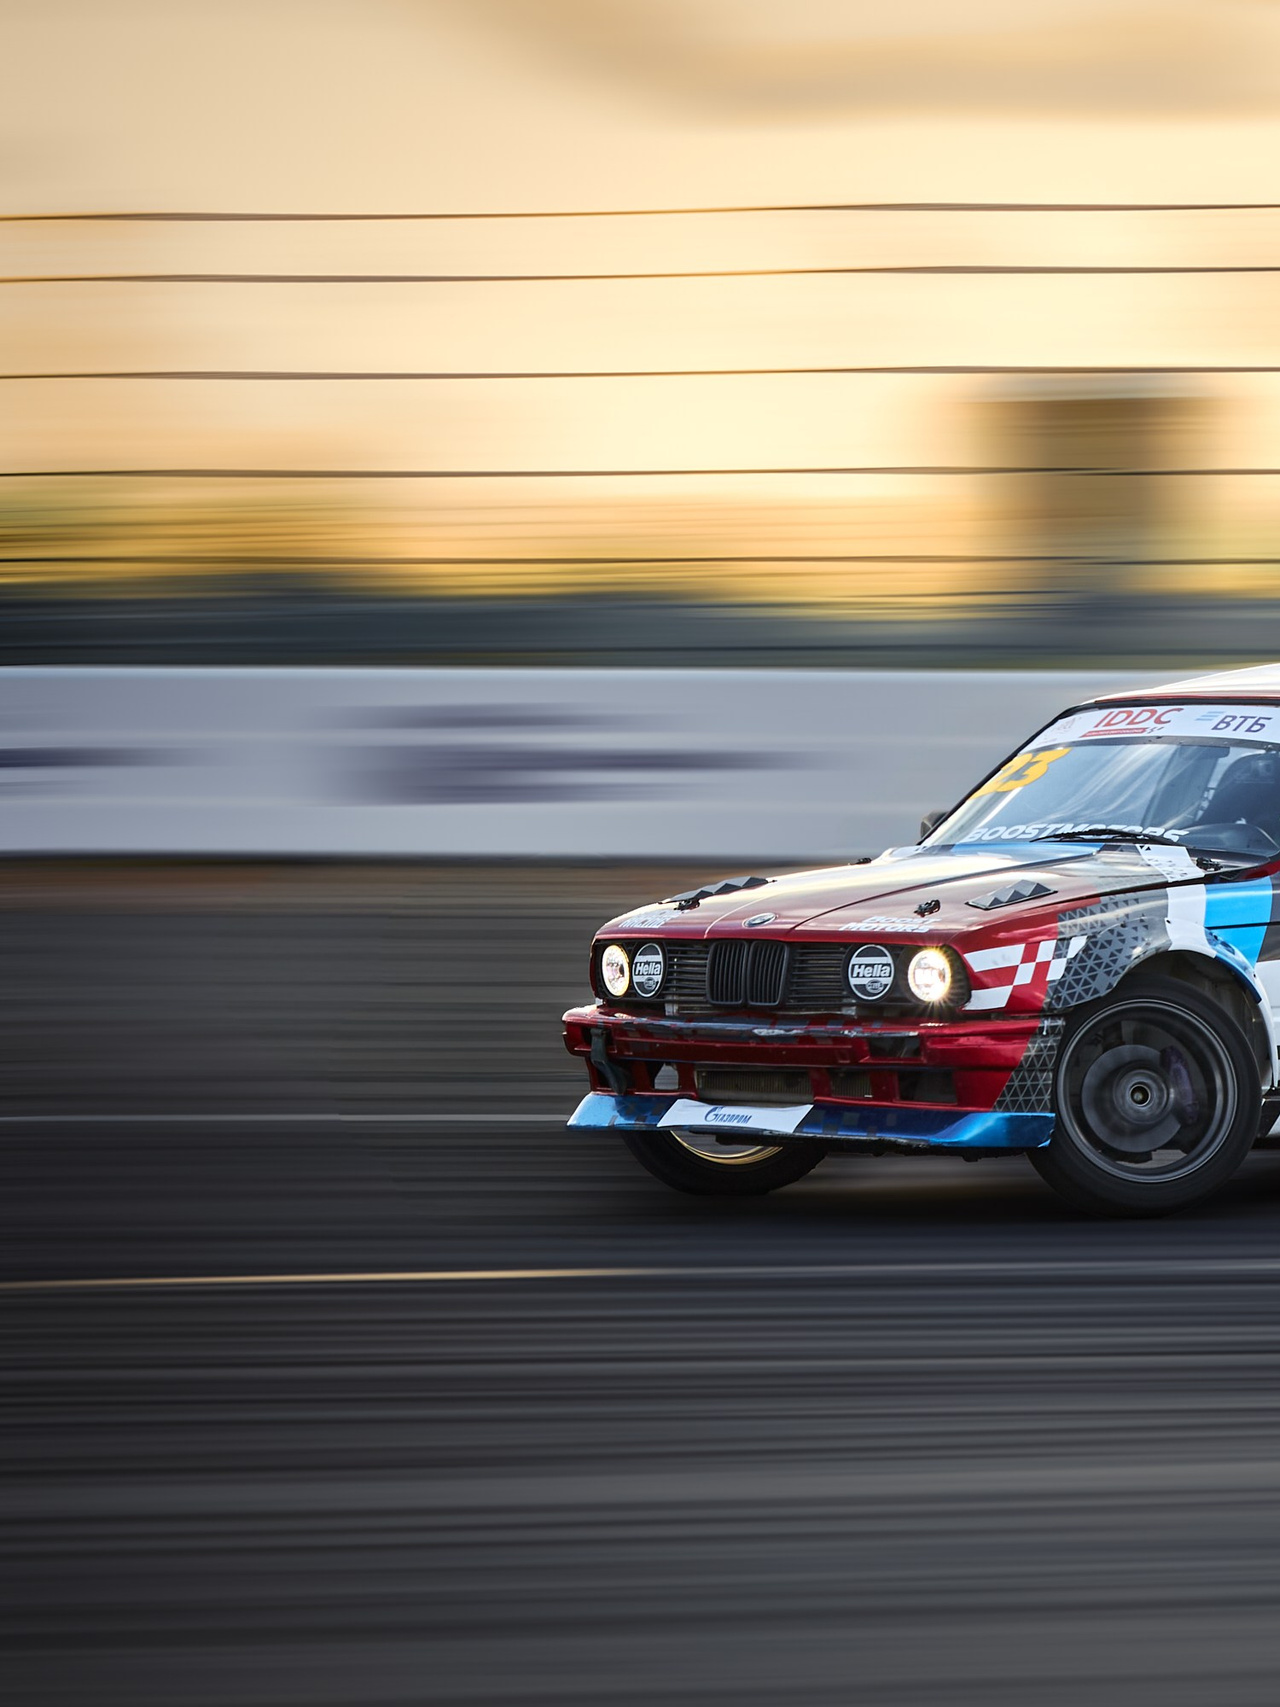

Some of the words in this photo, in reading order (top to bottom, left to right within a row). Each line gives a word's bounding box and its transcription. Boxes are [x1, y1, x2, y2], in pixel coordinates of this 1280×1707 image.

[1093, 708, 1184, 729] IDDC
[1211, 715, 1273, 733] ВТБ
[966, 748, 1072, 800] 23
[839, 922, 935, 933] MOTORS
[635, 962, 661, 975] Hella
[852, 964, 891, 978] Hella
